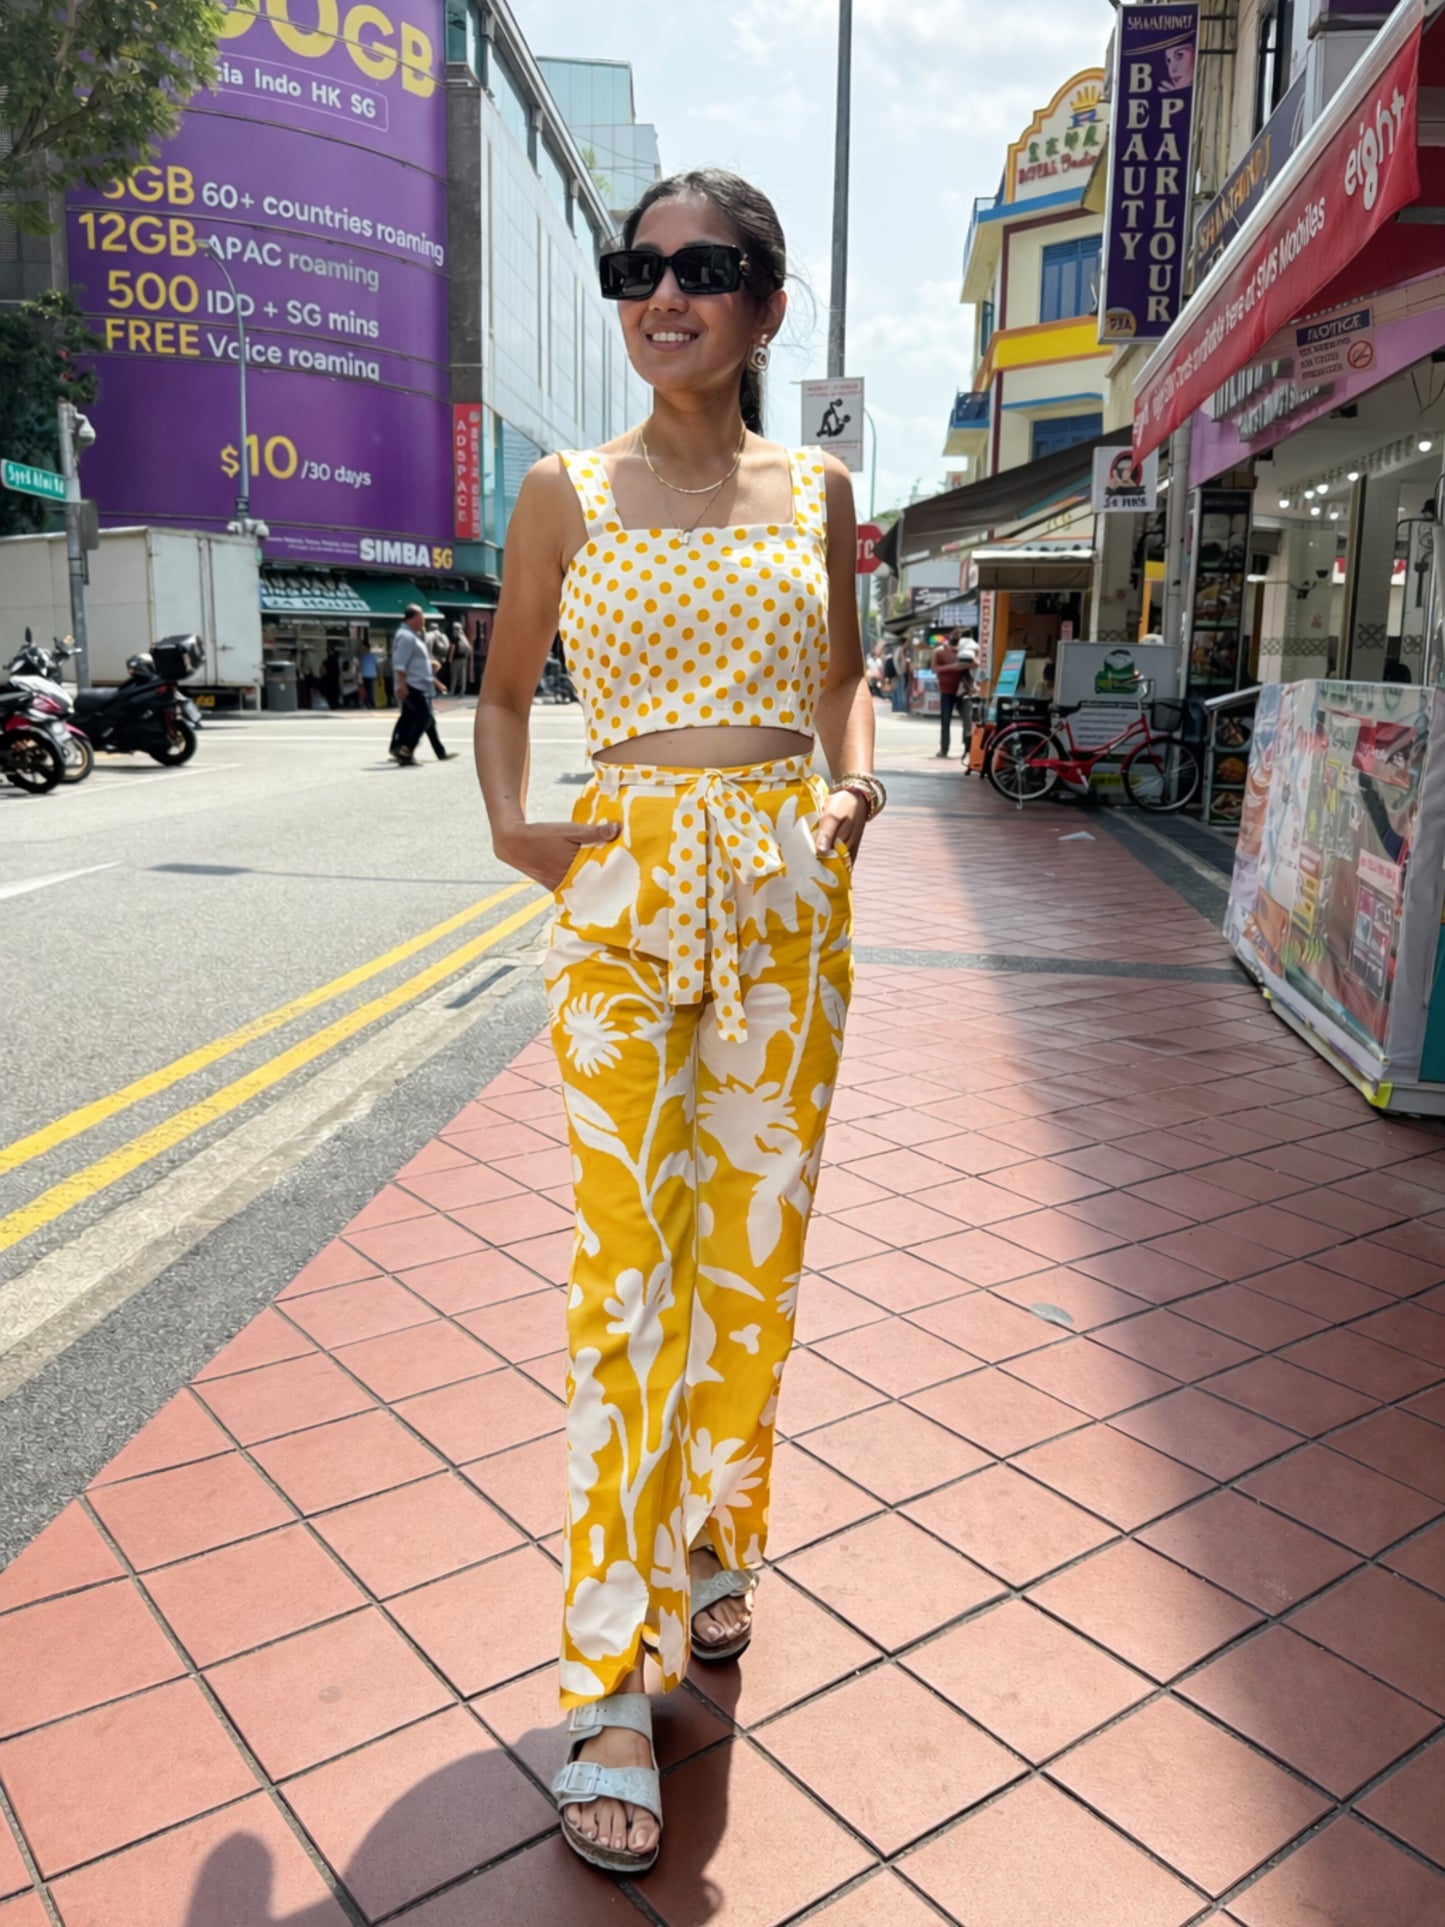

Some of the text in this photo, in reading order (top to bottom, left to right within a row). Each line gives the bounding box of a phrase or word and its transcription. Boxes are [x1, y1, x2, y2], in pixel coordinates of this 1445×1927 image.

[254, 67, 302, 97] Indo
[311, 81, 342, 109] HK
[350, 93, 377, 118] SG
[1119, 62, 1153, 260] BEAUTY
[1344, 86, 1405, 211] eight
[202, 181, 255, 211] 60+
[262, 195, 373, 238] countries
[376, 222, 445, 267] roaming
[1147, 98, 1184, 322] PARLOUR
[1279, 196, 1325, 275] Mobiles
[78, 211, 379, 292] 12GB APAC roaming
[107, 269, 379, 338] 500 IDD + SG mins
[105, 318, 200, 356] FREE
[288, 349, 380, 381] roaming
[334, 465, 372, 489] days
[359, 537, 431, 568] SIMBA
[431, 546, 454, 569] 5G
